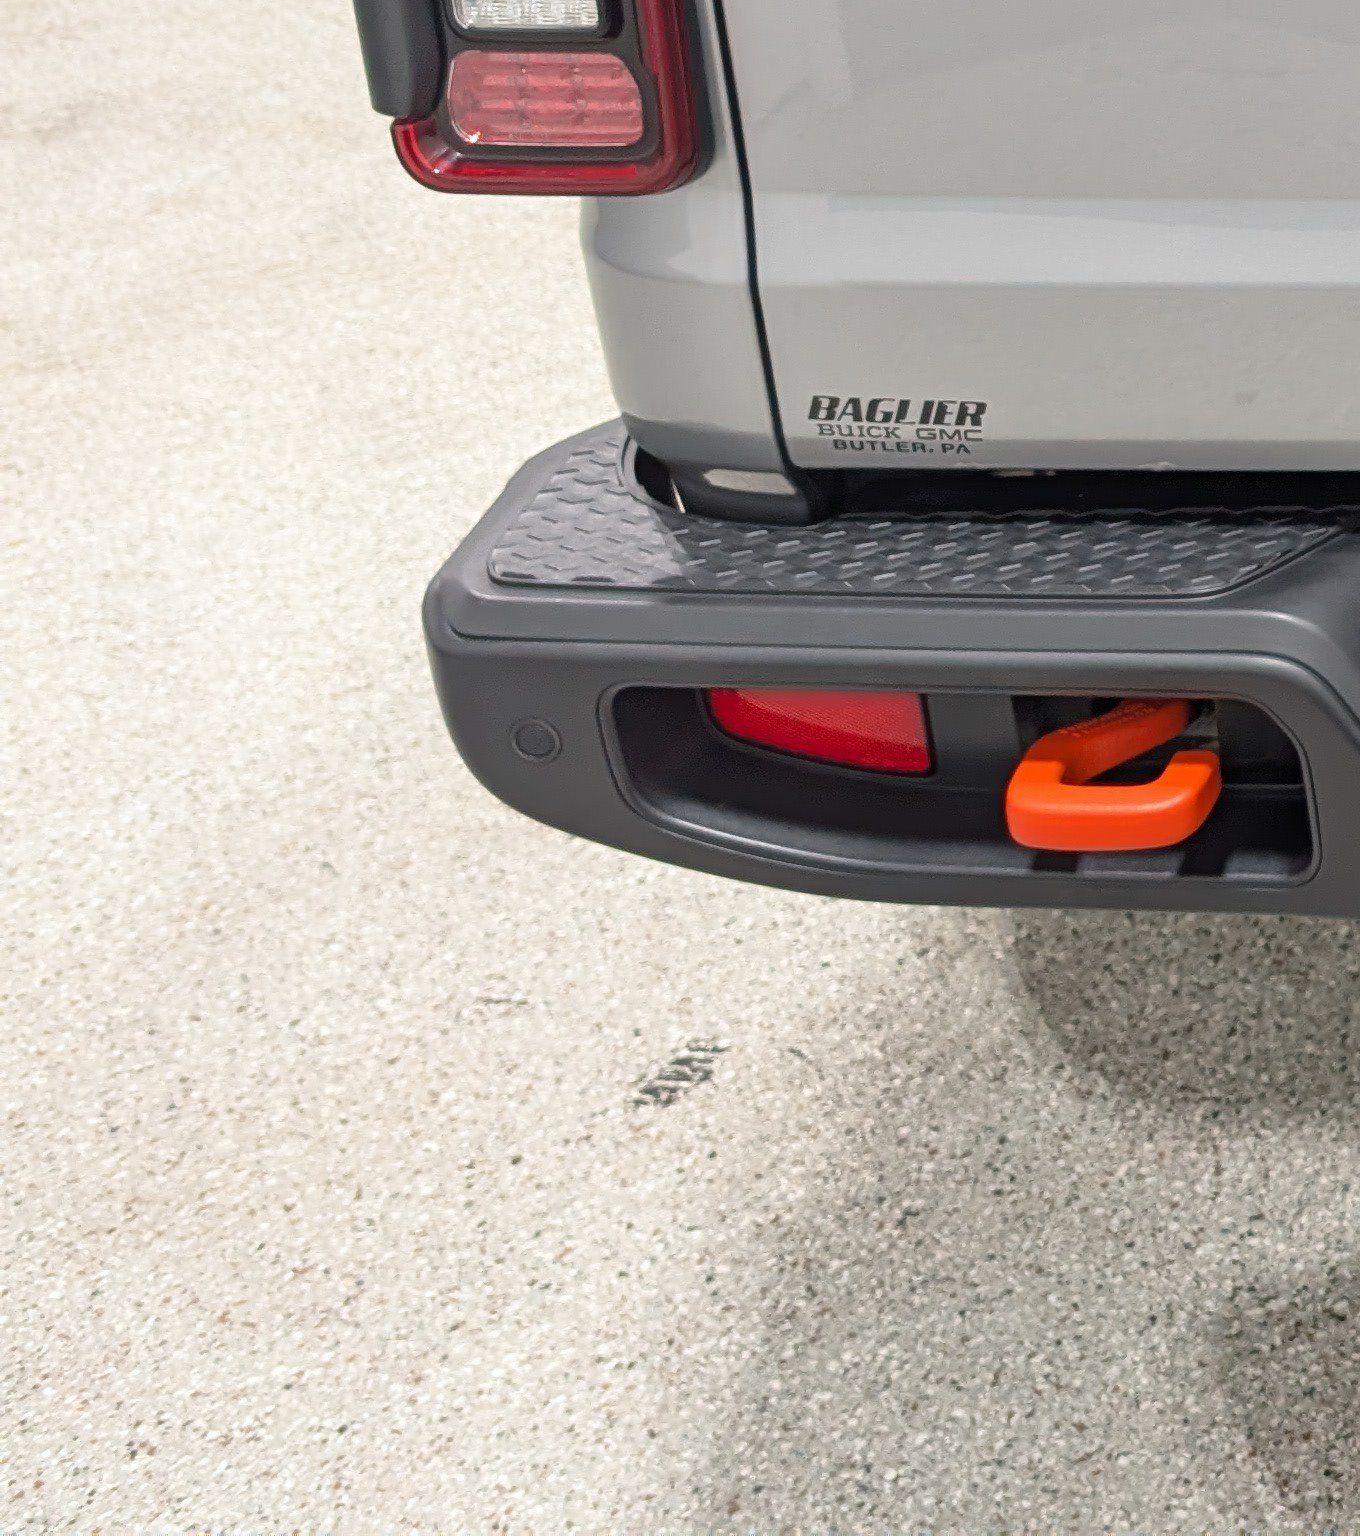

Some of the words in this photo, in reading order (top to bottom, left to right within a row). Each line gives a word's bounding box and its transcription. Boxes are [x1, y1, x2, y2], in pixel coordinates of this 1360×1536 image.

[808, 395, 987, 427] BAGLIER
[817, 423, 899, 439] BUICK
[916, 427, 983, 442] GMC
[941, 443, 971, 454] PA
